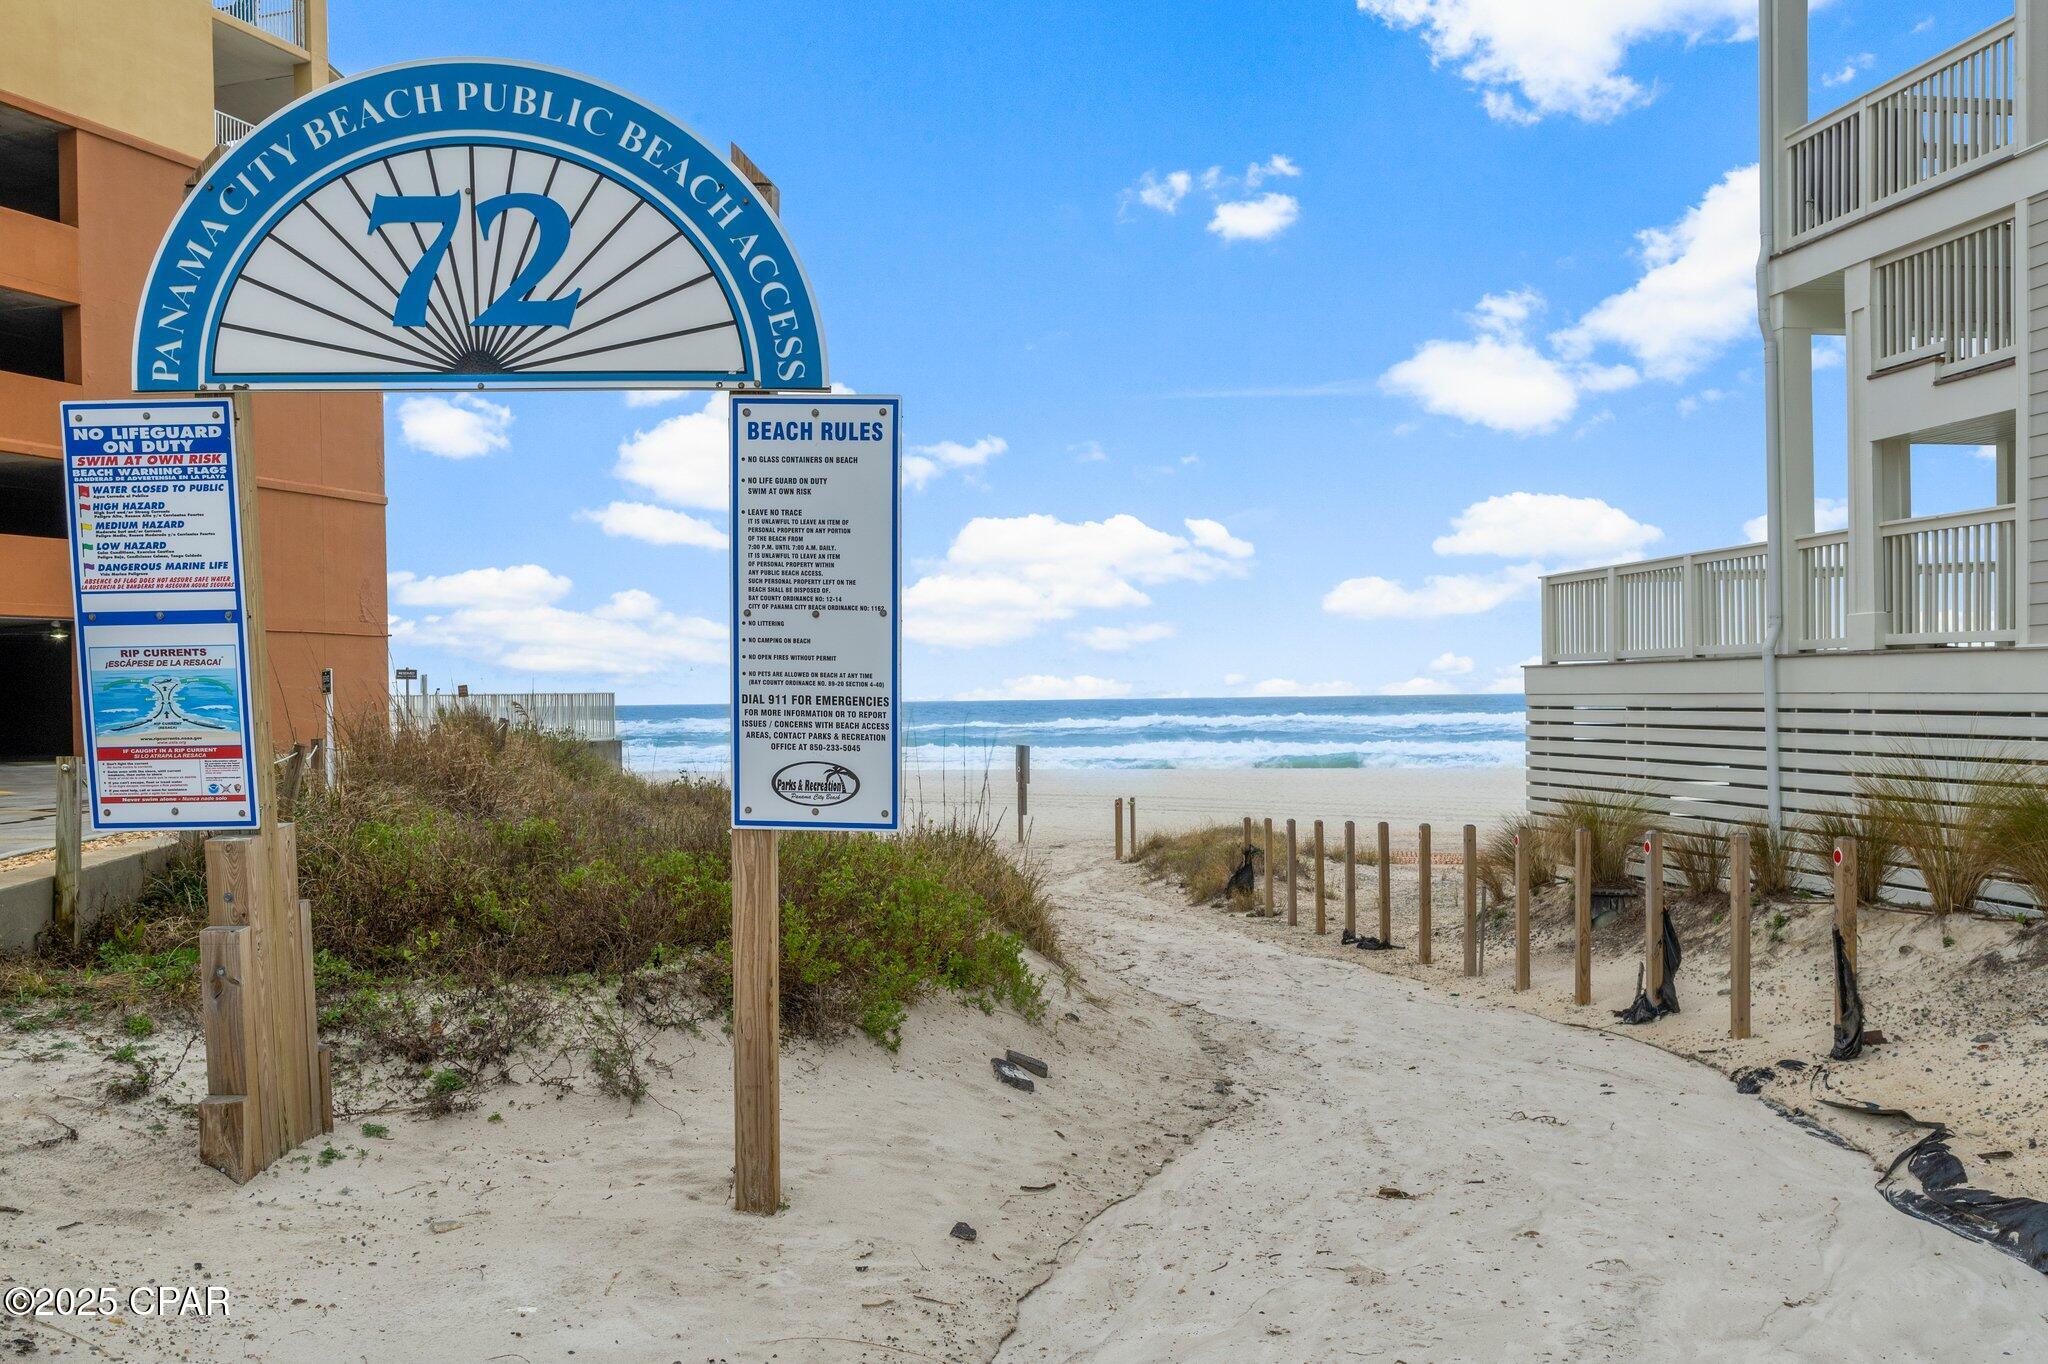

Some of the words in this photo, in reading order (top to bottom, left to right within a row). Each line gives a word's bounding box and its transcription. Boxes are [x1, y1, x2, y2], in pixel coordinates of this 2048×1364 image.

[151, 220, 230, 382] PANAMA
[219, 134, 298, 215] CITY
[302, 84, 443, 150] BEACH
[456, 82, 614, 136] PUBLIC
[617, 120, 744, 230] BEACH
[730, 234, 806, 382] ACCESS
[367, 189, 582, 330] 72
[74, 428, 104, 440] NO
[112, 426, 222, 440] LIFEGUARD
[748, 421, 813, 441] BEACH
[821, 422, 883, 441] RULES
[103, 440, 133, 453] ON
[142, 440, 193, 453] DUTY
[77, 456, 118, 466] SWIM
[124, 456, 142, 465] AT
[147, 455, 184, 465] OWN
[189, 454, 222, 466] RISK
[72, 469, 113, 478] BEACH
[118, 467, 182, 478] WARNING
[186, 466, 227, 476] FLAGS
[92, 486, 127, 494] WATER
[131, 485, 169, 493] CLOSED
[190, 484, 224, 492] PUBLIC
[93, 503, 119, 512] HIGH
[122, 502, 165, 512] HAZARD
[96, 521, 138, 530] MEDIUM
[142, 521, 184, 530] HAZARD
[97, 542, 120, 550] LOW
[125, 542, 166, 551] HAZARD
[98, 563, 162, 572] DANGEROUS
[165, 562, 205, 570] MARINE
[143, 648, 207, 657] CURRENTS
[106, 659, 154, 669] ¡ESCÁPESE
[742, 694, 765, 704] DIAL
[768, 694, 786, 705] 911
[792, 695, 812, 705] FOR
[816, 695, 889, 707] EMERGENCIES
[784, 709, 833, 718] INFORMATION
[774, 720, 813, 728] CONCERNS
[861, 722, 890, 730] ACCESS
[746, 731, 771, 739] AREAS,
[774, 732, 806, 740] CONTACT
[842, 733, 886, 742] RECREATION
[810, 744, 860, 752] 850-233-5045
[777, 779, 796, 790] Parks
[798, 779, 803, 791] &
[805, 780, 842, 792] Recreation
